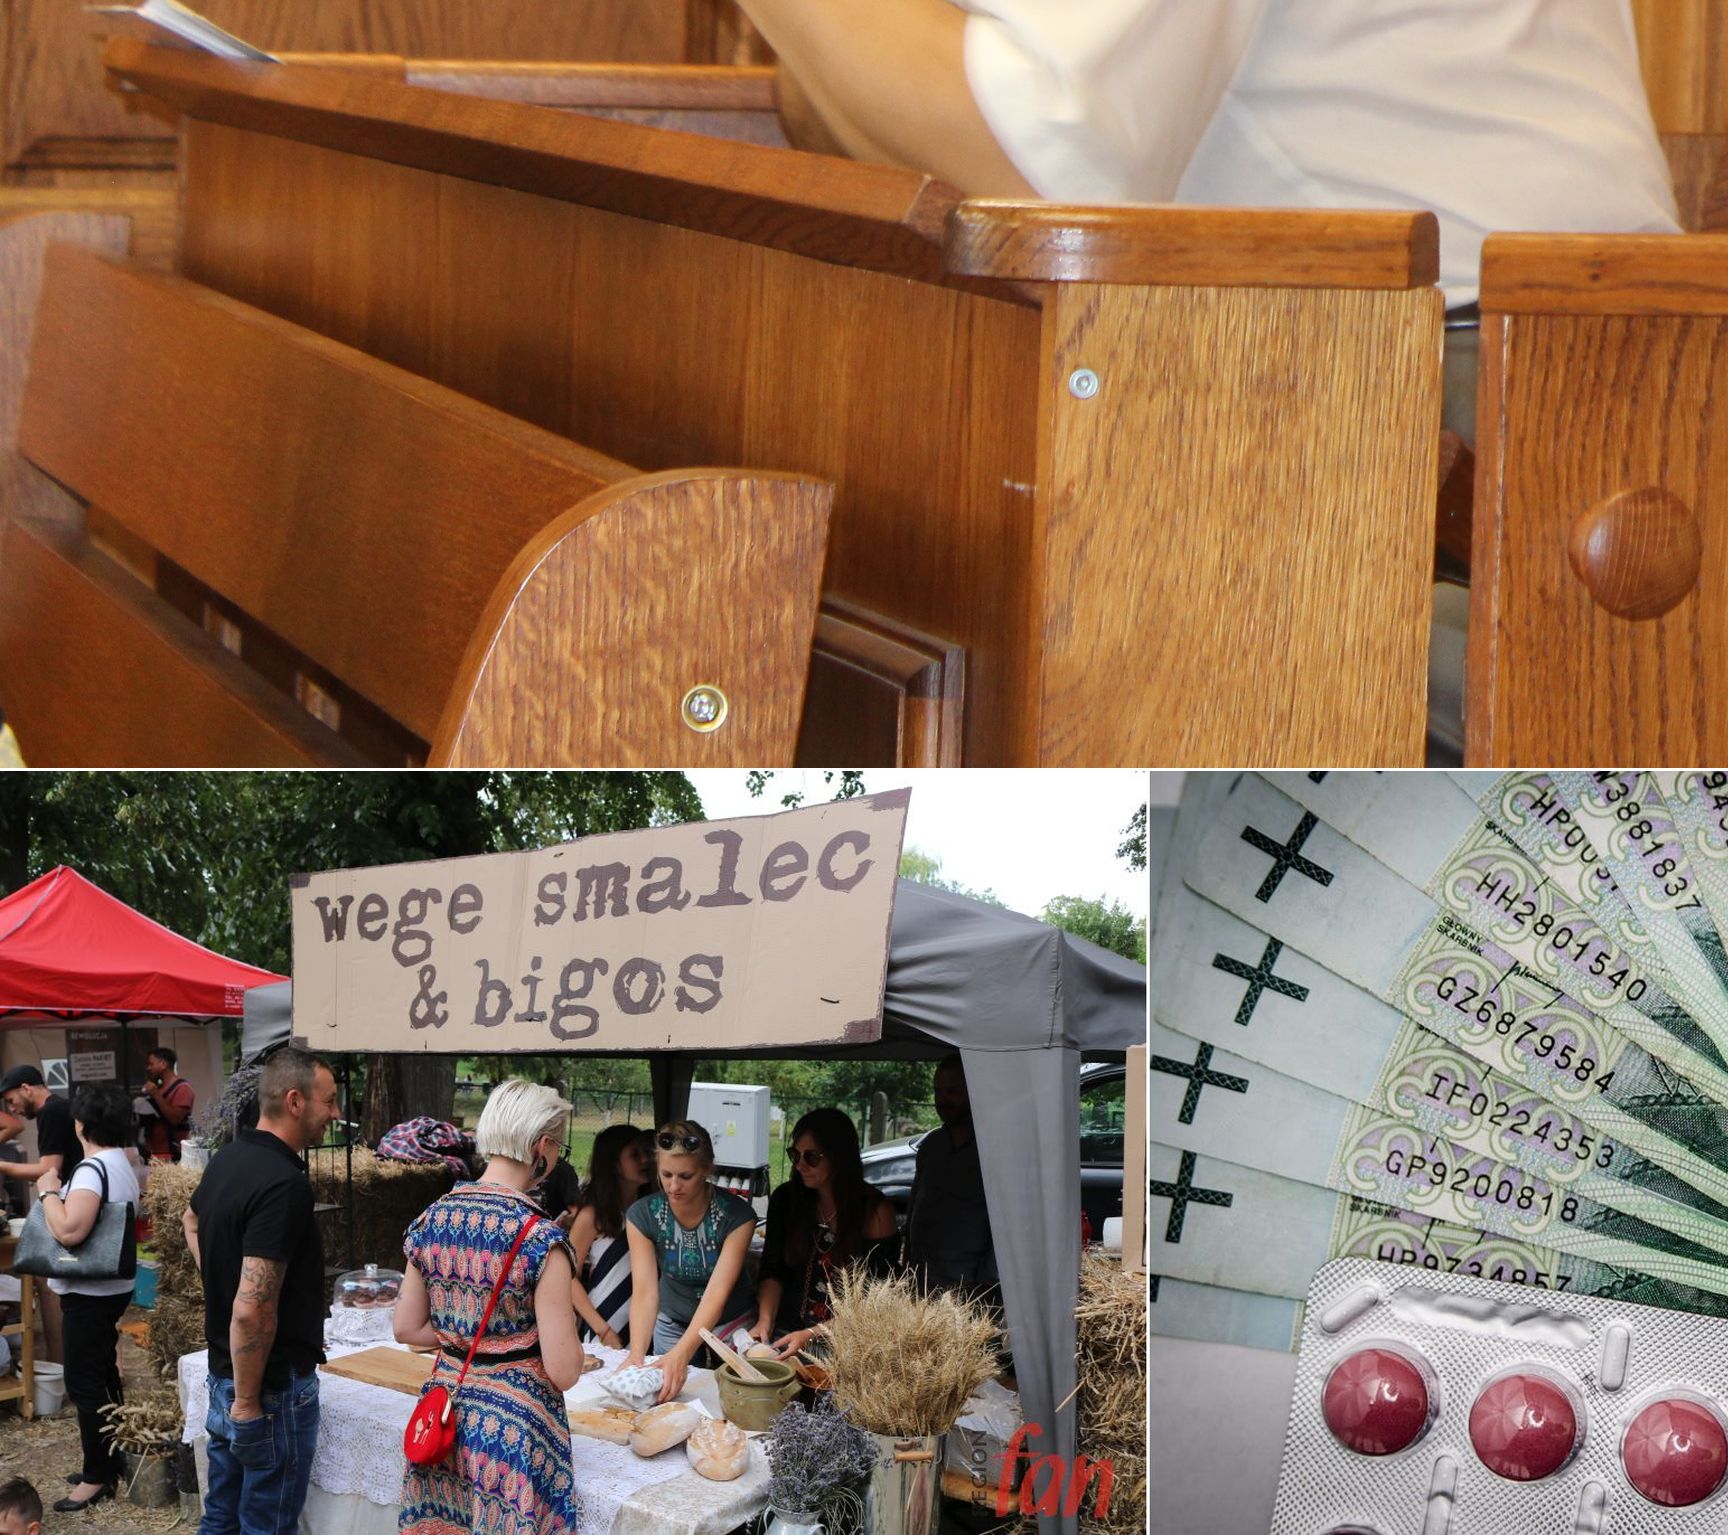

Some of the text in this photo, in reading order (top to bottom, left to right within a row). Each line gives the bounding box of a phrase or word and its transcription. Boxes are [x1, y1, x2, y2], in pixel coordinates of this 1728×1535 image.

[311, 829, 876, 967] wege smalec
[1476, 872, 1648, 1002] HH2801540
[409, 952, 724, 1042] & bigos
[1436, 976, 1616, 1095] GZ6879584
[1424, 1072, 1615, 1169] IF0224353
[1385, 1149, 1579, 1223] GP9200818
